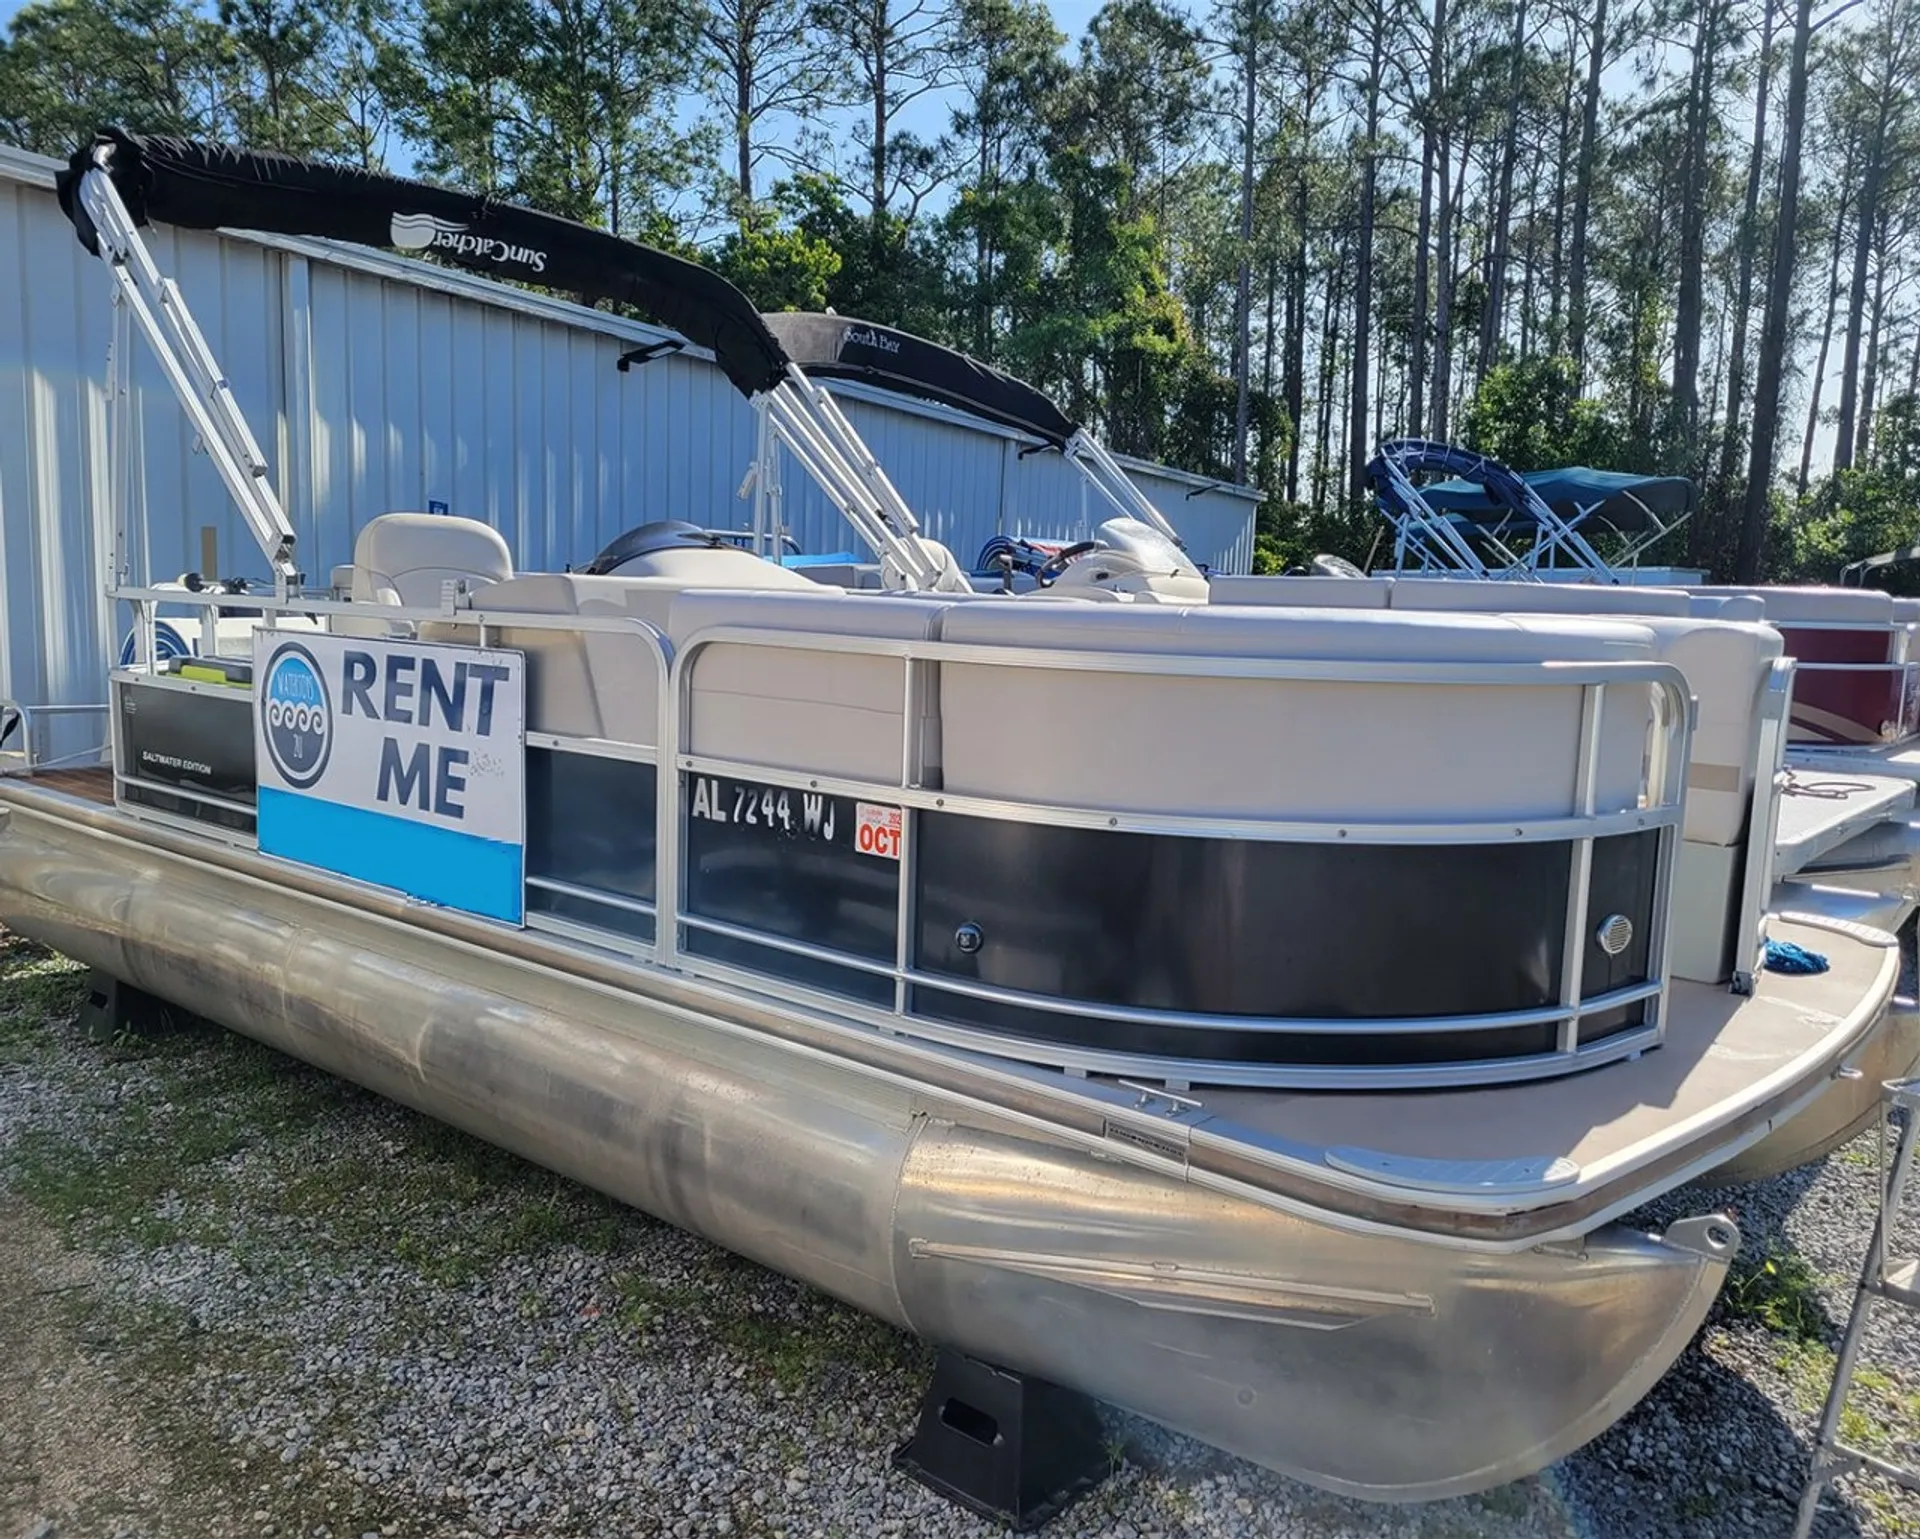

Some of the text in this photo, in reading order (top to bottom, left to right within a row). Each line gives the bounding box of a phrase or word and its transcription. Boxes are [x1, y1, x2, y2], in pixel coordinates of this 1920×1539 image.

[431, 231, 548, 272] SunCatcher
[341, 649, 510, 737] RENT
[142, 750, 212, 776] SALTWATER EDITION
[376, 736, 470, 820] ME
[692, 777, 836, 841] AL 7244 WJ
[860, 823, 901, 857] OCT
